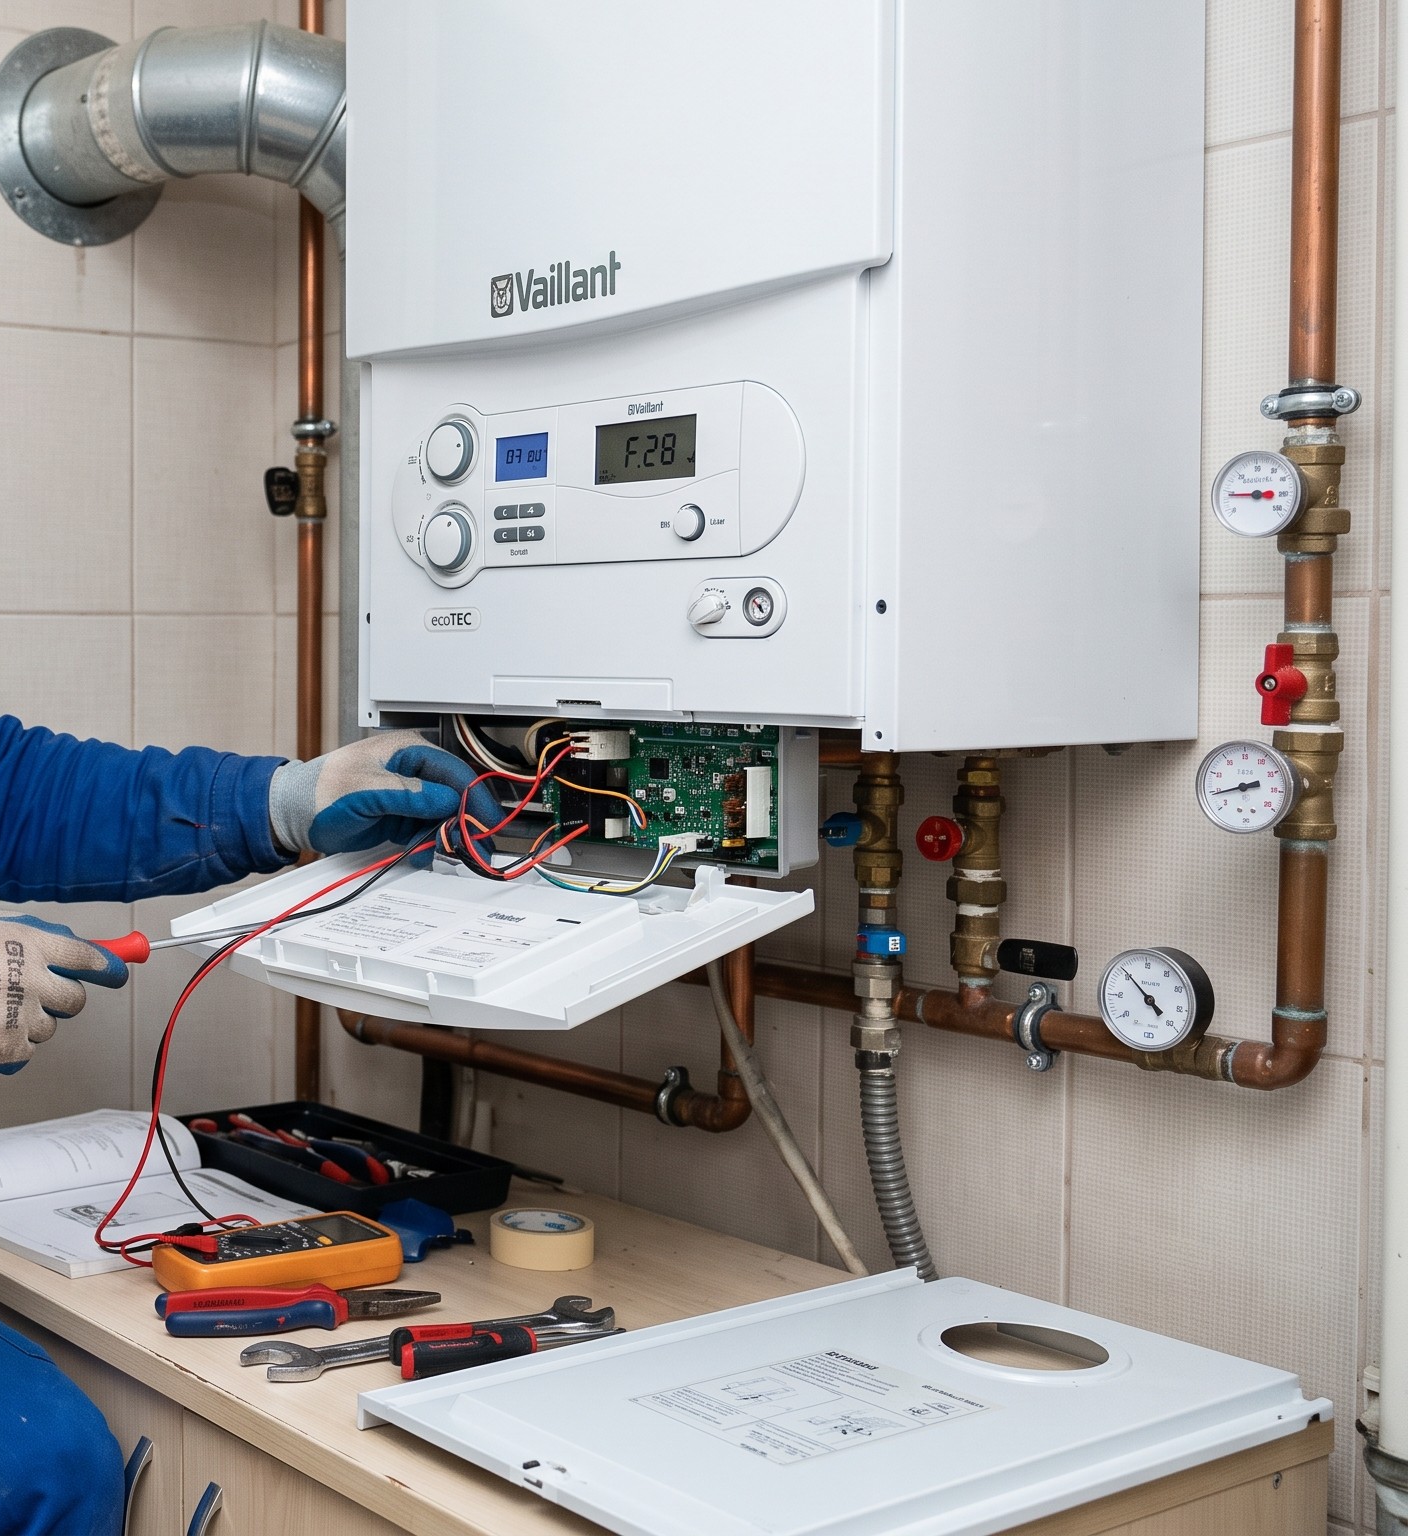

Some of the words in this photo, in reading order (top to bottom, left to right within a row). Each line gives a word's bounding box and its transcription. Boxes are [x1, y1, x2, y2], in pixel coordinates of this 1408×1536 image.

[515, 250, 621, 312] Vaillant
[635, 400, 664, 415] Vaillant
[624, 432, 677, 468] F.28
[431, 612, 472, 626] ecoTEC
